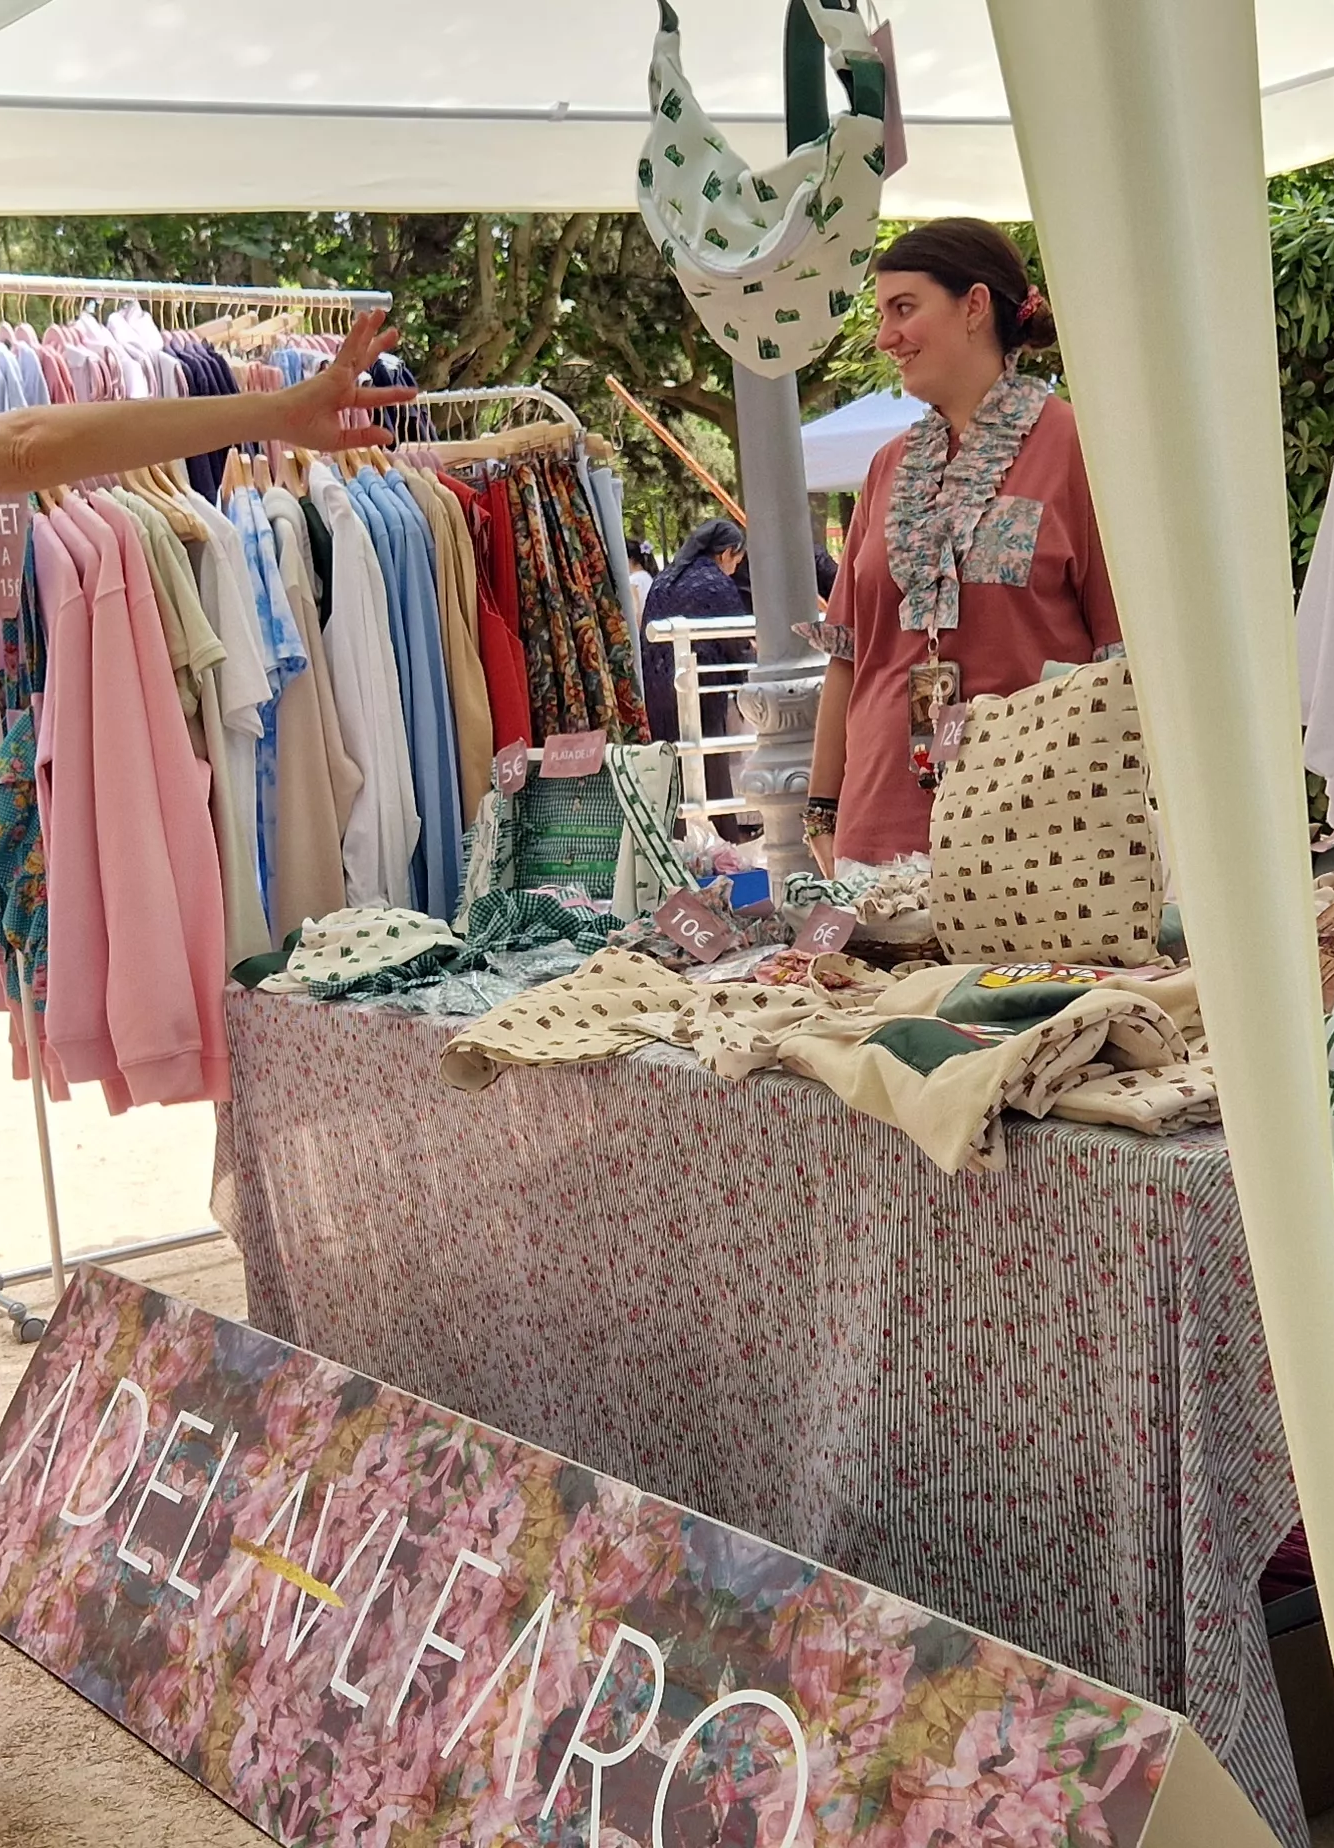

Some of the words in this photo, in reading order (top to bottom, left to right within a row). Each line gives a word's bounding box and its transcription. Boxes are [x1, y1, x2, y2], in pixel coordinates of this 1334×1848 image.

[940, 719, 965, 747] 12€
[501, 754, 524, 784] 5€
[670, 907, 715, 949] 10€
[813, 922, 840, 945] 6€
